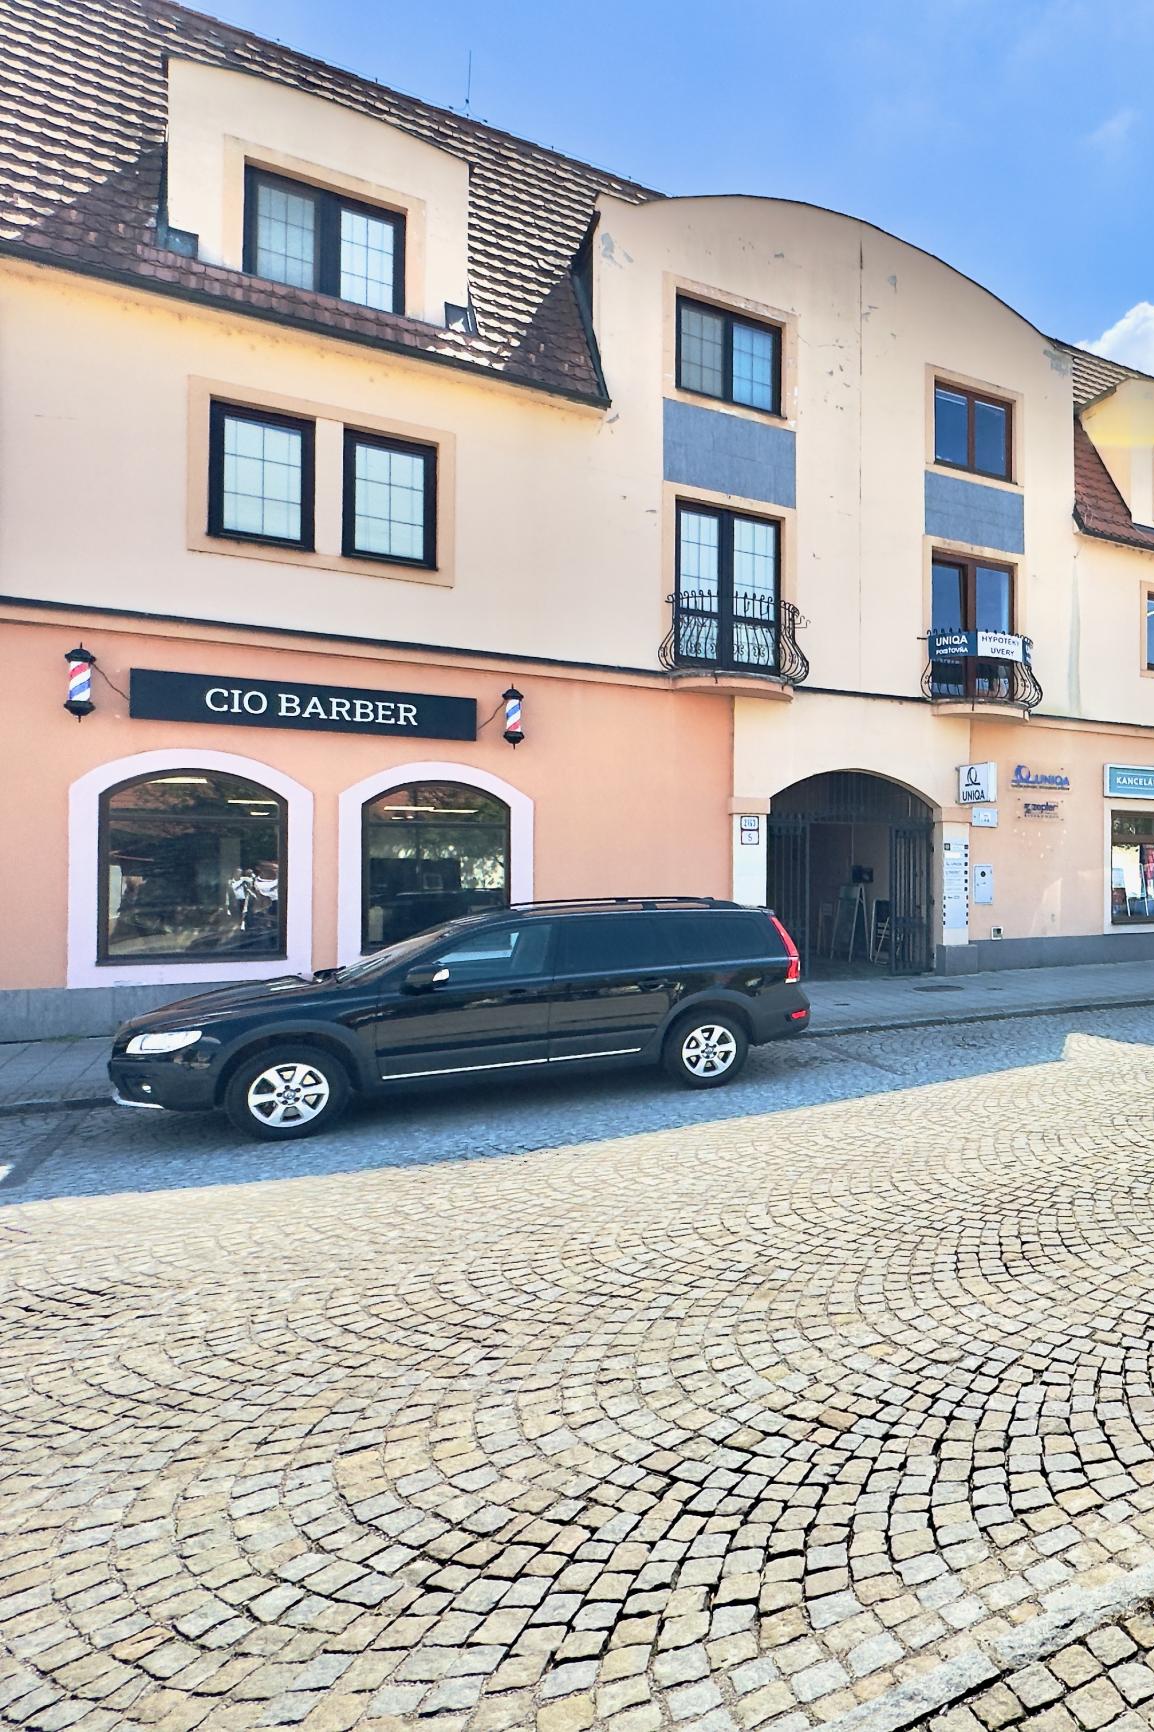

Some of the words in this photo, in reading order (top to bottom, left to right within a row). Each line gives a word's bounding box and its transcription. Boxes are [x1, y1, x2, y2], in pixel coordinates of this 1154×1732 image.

[936, 635, 968, 647] UNIQA
[205, 688, 268, 714] CIO
[278, 693, 418, 726] BARBER
[962, 789, 985, 801] UNIQA
